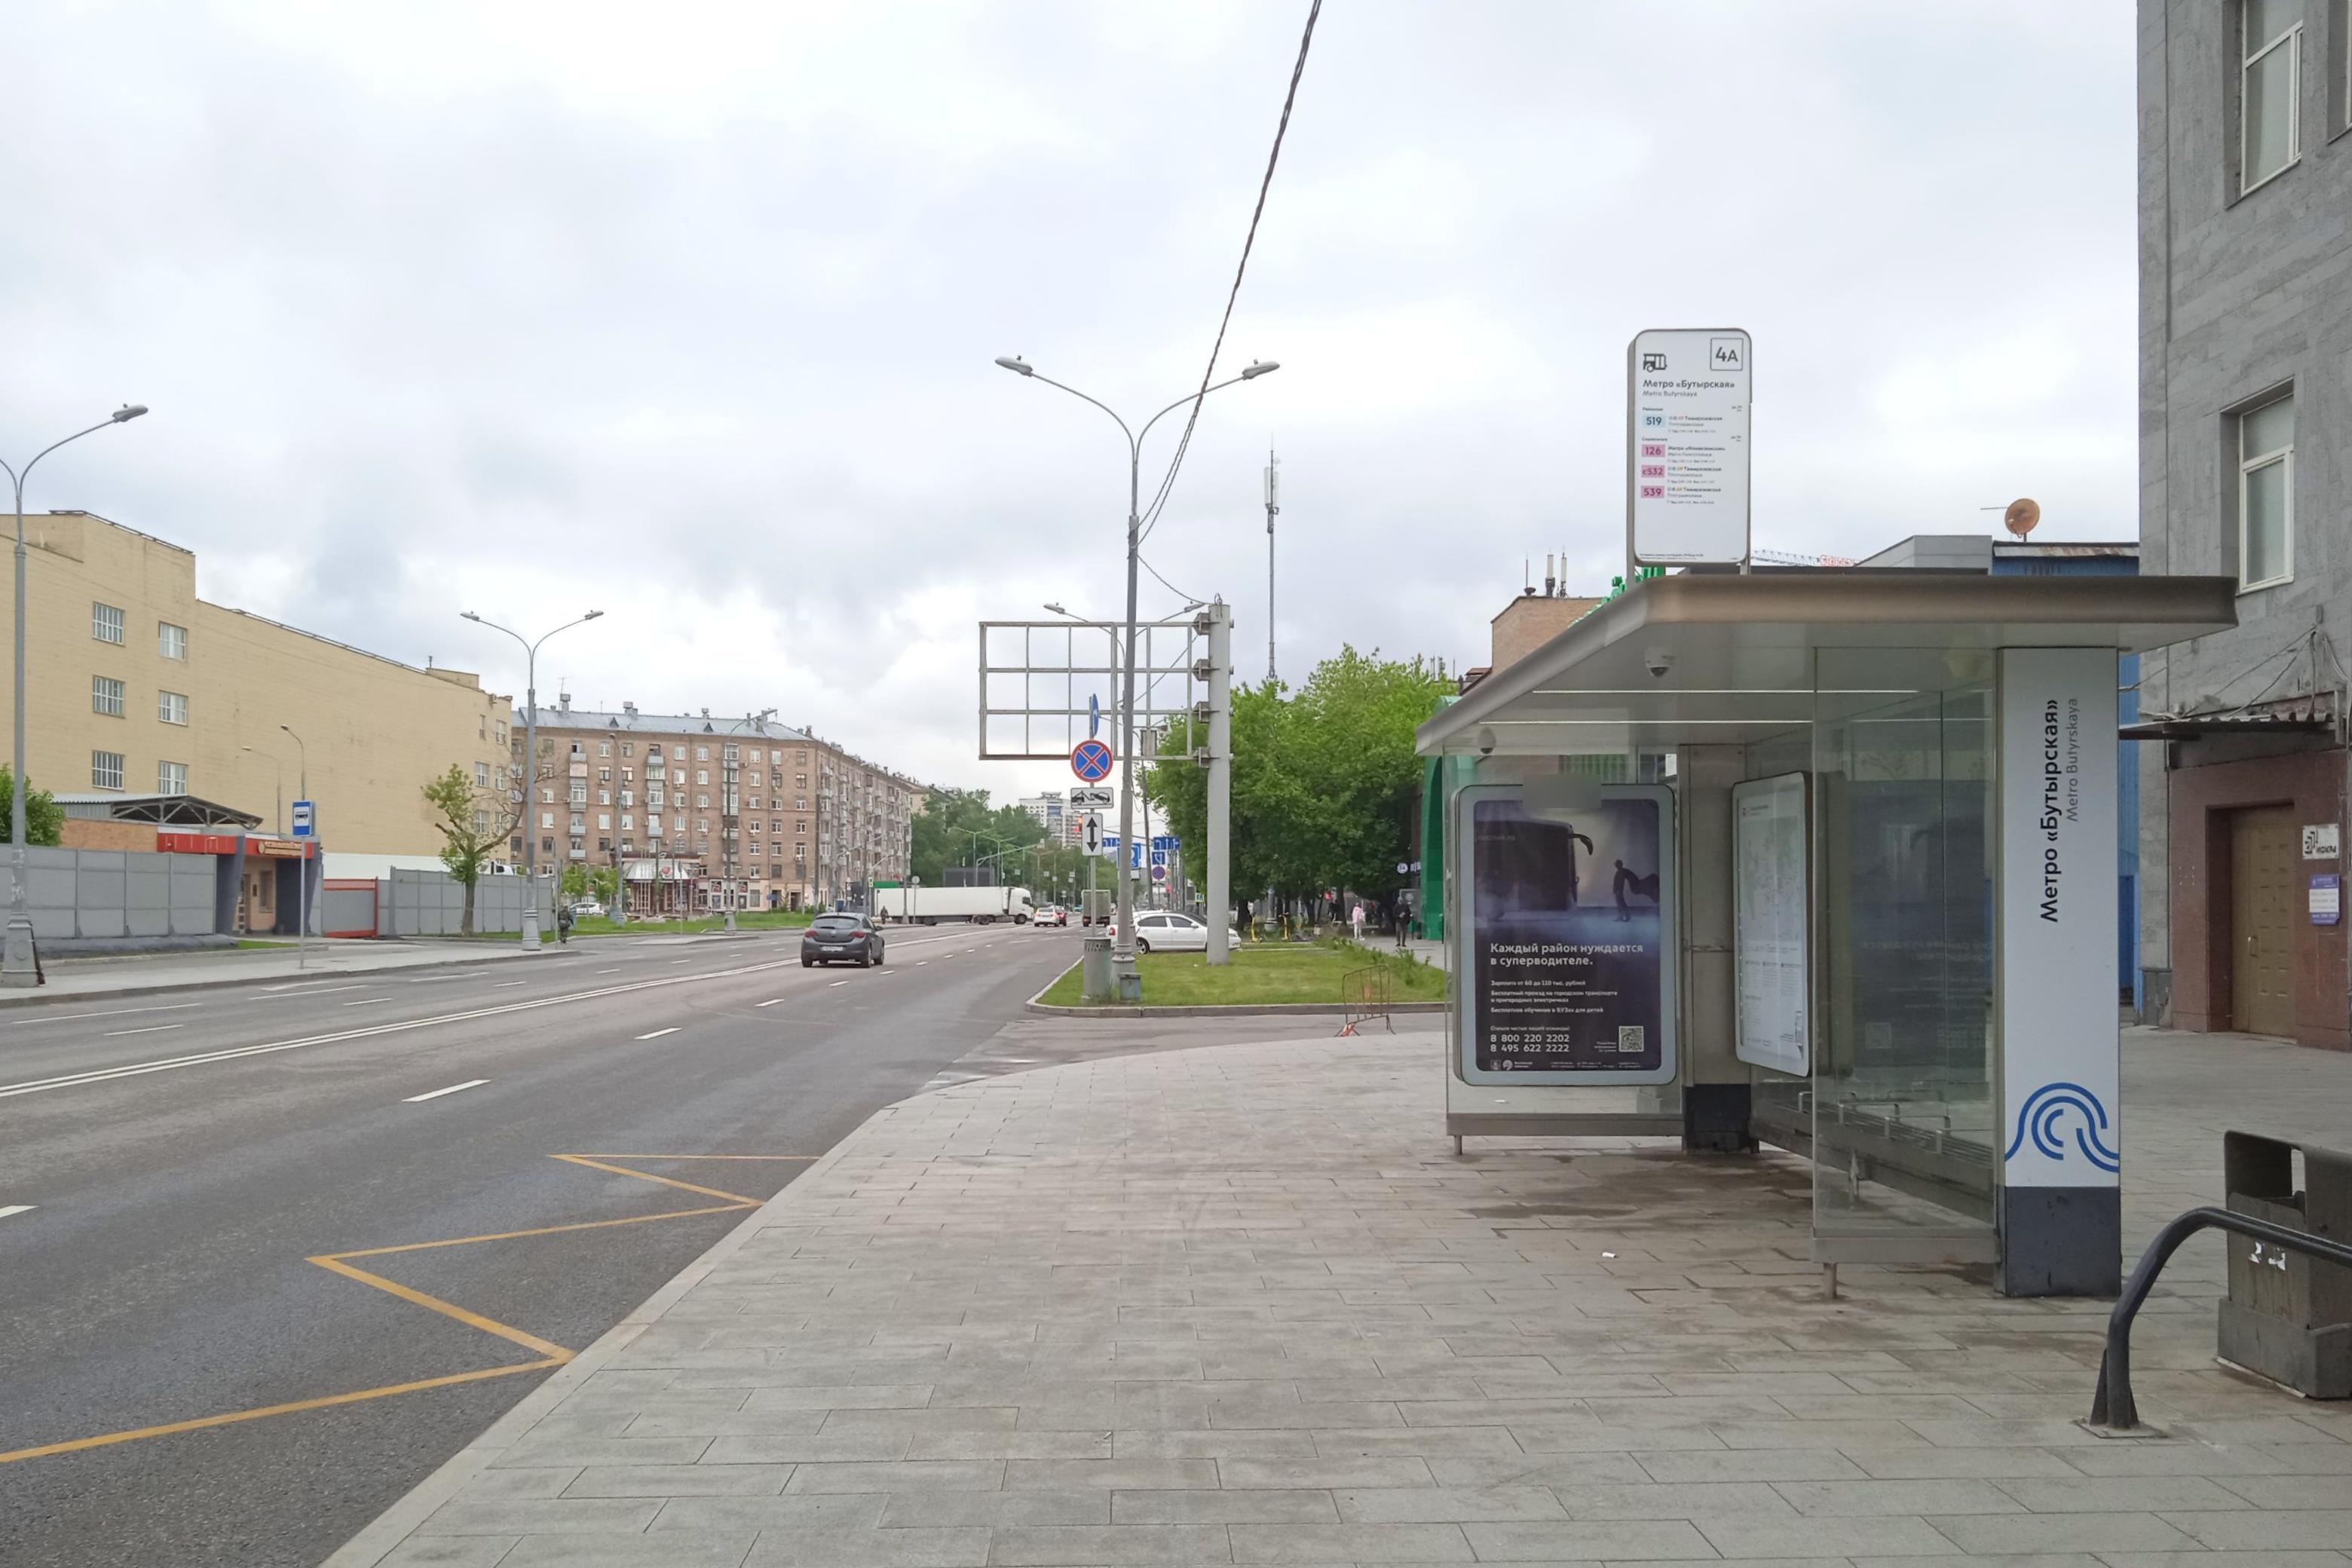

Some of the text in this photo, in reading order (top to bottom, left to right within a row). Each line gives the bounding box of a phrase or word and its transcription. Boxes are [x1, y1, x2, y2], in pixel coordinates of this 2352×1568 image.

[1715, 347, 1738, 362] 4А
[1642, 379, 1735, 390] Метро «Бутырская»
[1646, 416, 1662, 426] 519
[1645, 446, 1661, 455] 126
[1643, 488, 1662, 497] 539
[2066, 698, 2081, 822] Metro Butyrskaya
[2040, 699, 2063, 923] Метро «Бутырская»
[1490, 943, 1643, 955] Каждый район нуждается
[1500, 957, 1594, 967] суперводителе.
[1490, 1034, 1570, 1043] 8 800 220 2202
[1490, 1044, 1570, 1052] 8 495 622 2222
